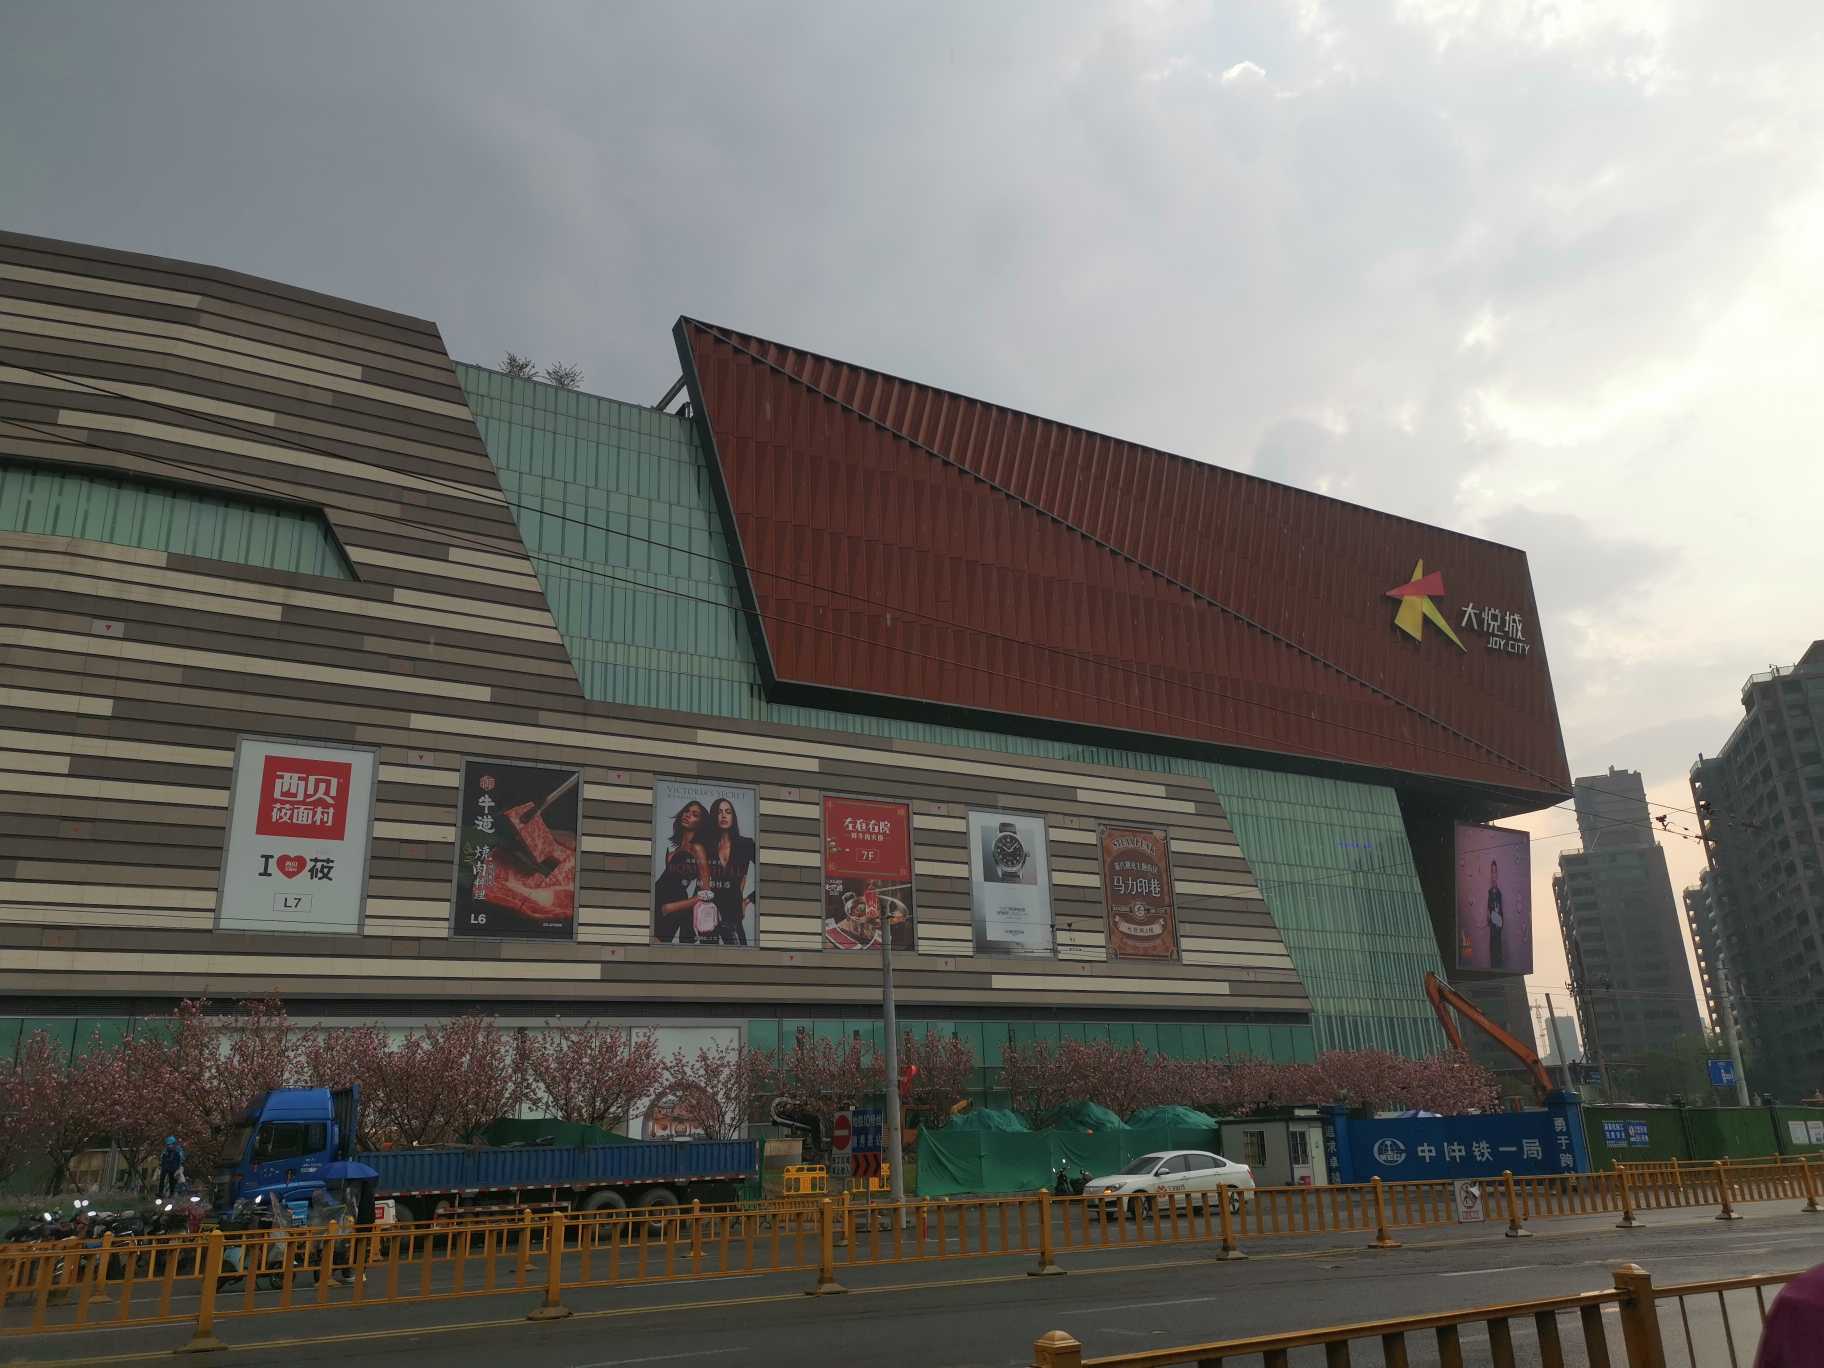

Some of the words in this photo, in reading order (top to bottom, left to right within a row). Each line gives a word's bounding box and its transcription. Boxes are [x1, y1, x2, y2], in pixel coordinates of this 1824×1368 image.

[1461, 603, 1526, 640] 大悦城
[1488, 637, 1506, 651] JOY
[1508, 641, 1530, 655] CITY
[273, 772, 338, 804] 西贝
[271, 804, 336, 827] 莜面村
[474, 794, 496, 834] 牛道
[861, 850, 875, 861] 7F
[258, 854, 274, 877] I
[307, 857, 335, 881] 莜
[1112, 875, 1161, 897] 马力印巷
[283, 897, 302, 909] L7
[470, 913, 487, 925] L6
[1417, 1138, 1543, 1164] 中中铁一局
